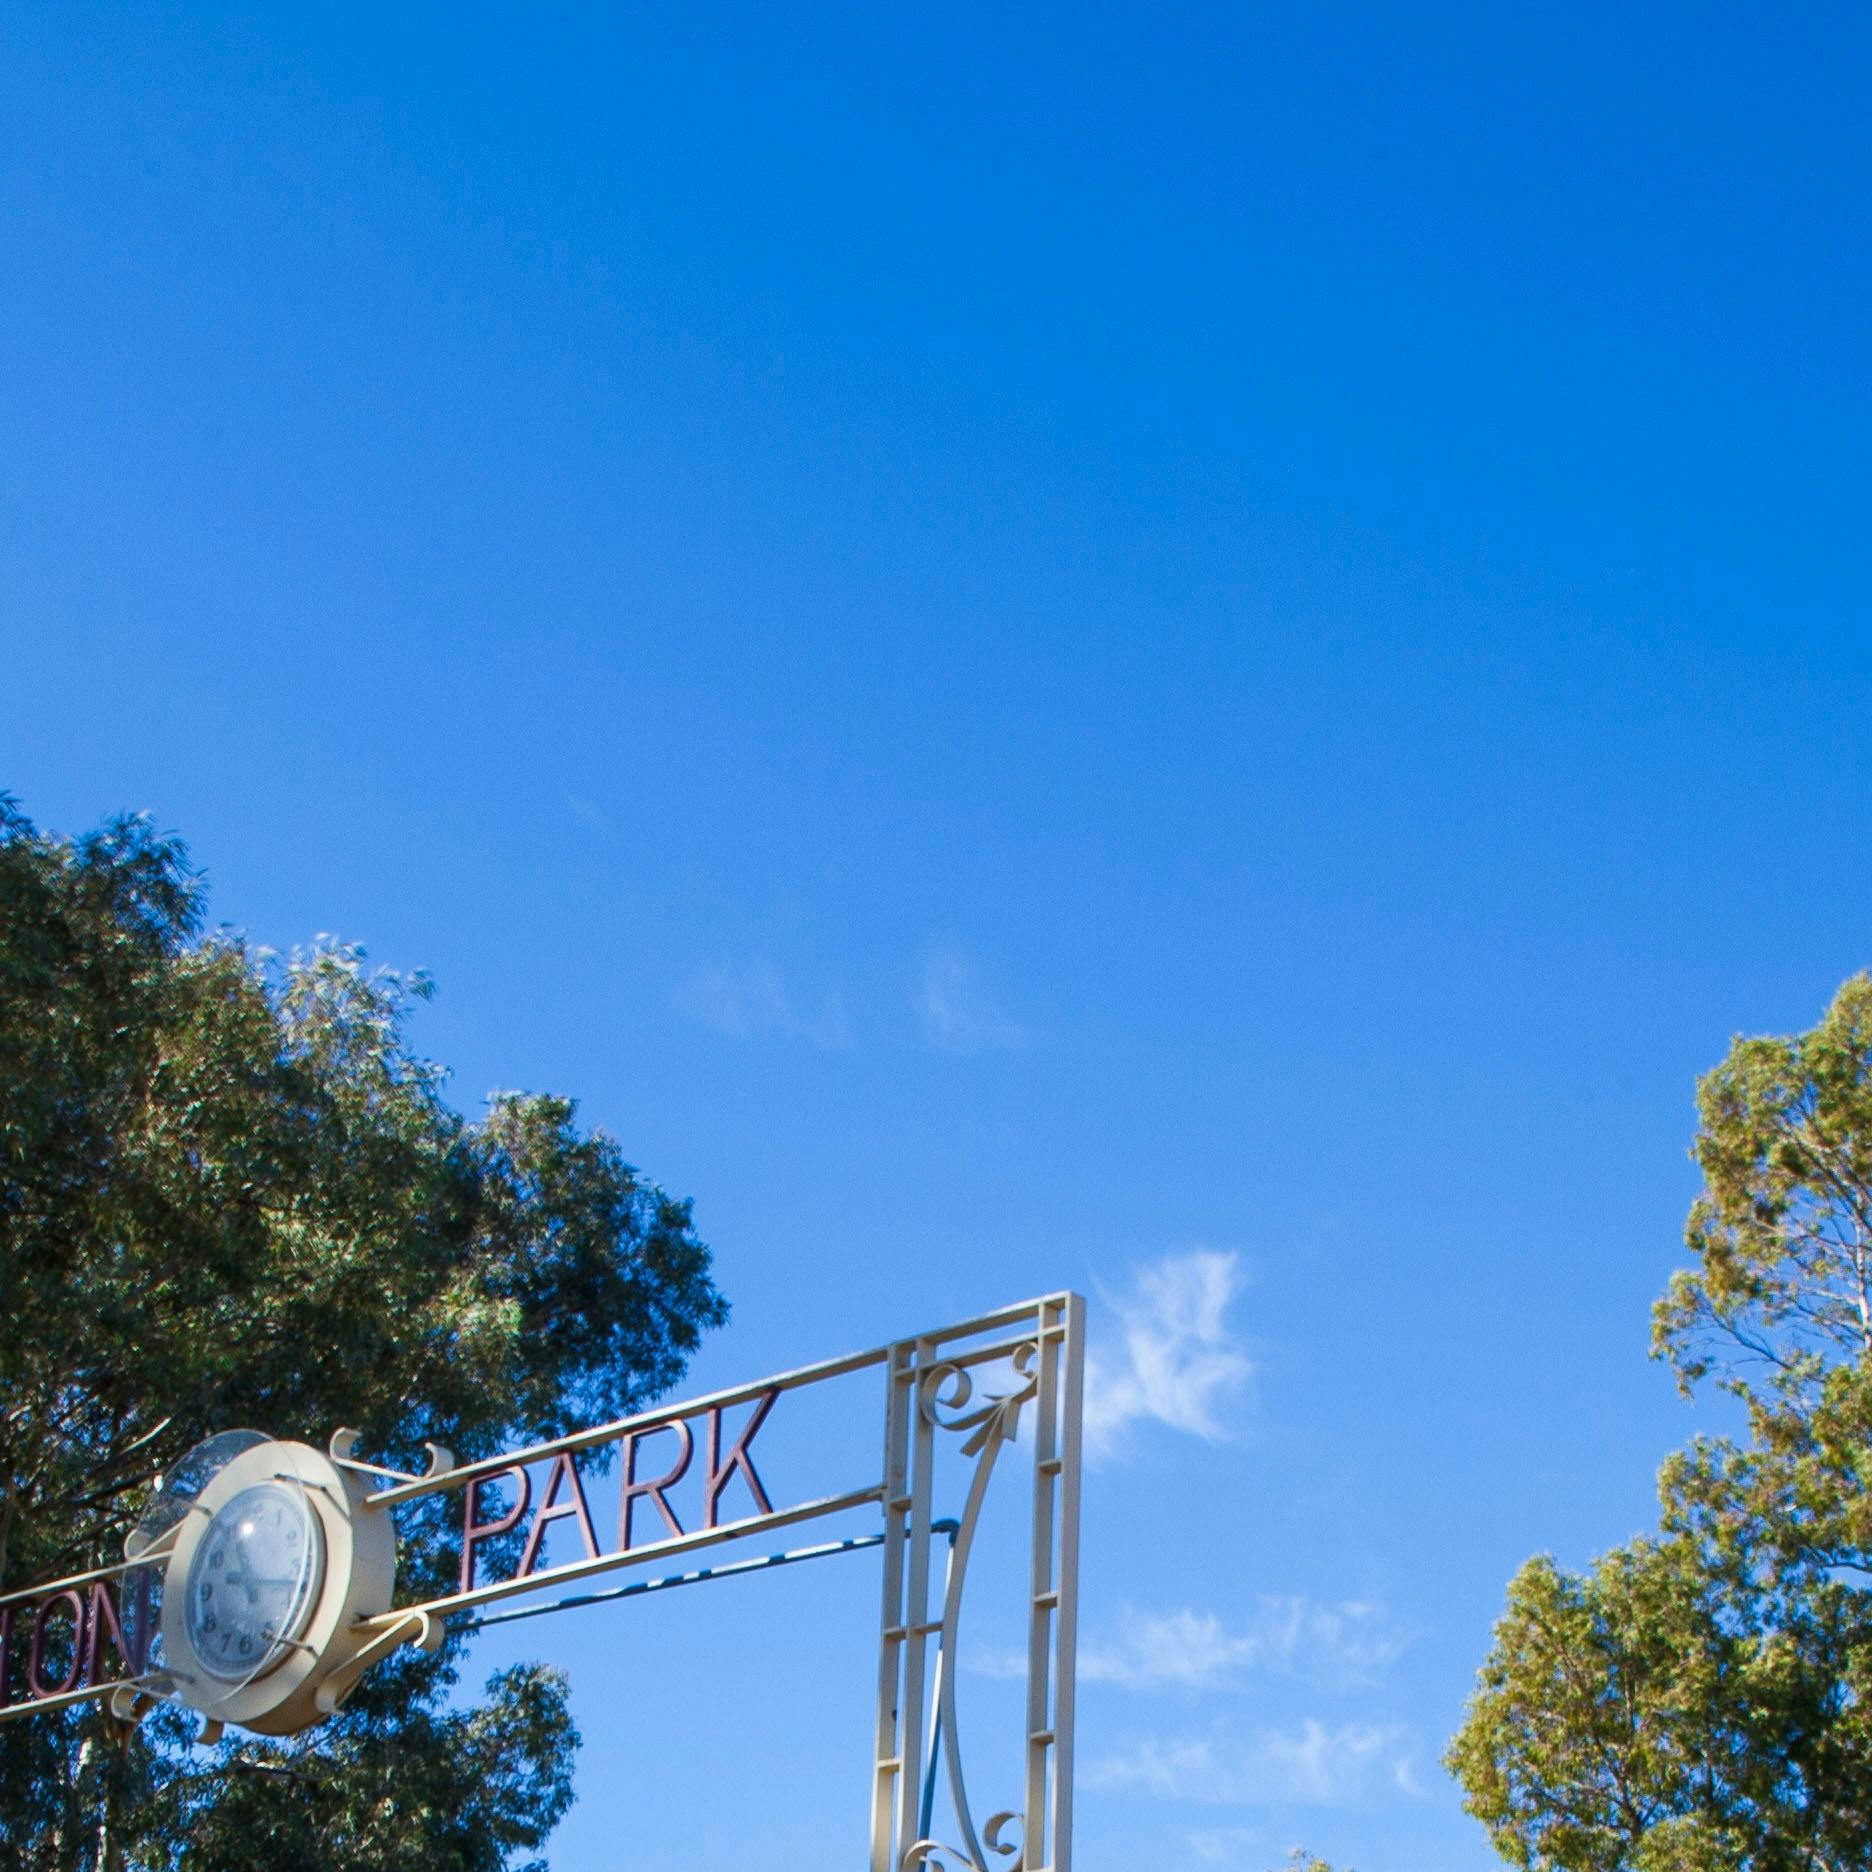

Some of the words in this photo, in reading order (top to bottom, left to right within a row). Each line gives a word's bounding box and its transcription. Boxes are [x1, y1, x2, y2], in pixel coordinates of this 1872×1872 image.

[460, 1388, 781, 1593] PARK
[199, 1582, 213, 1602] 9
[222, 1631, 234, 1653] 7
[238, 1635, 253, 1656] 6
